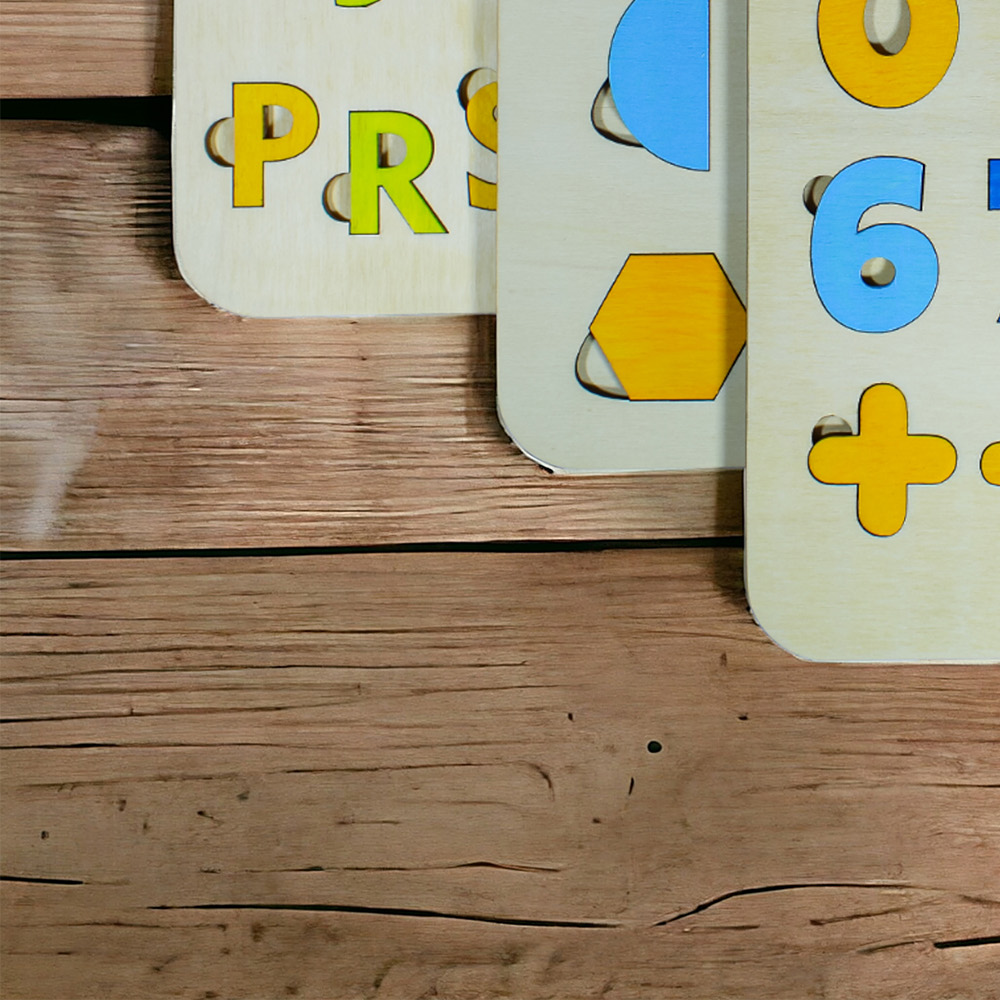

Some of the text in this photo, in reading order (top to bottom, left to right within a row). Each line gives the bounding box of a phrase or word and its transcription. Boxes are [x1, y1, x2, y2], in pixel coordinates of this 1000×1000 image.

[232, 81, 320, 208] P
[348, 110, 449, 235] R
[809, 155, 940, 334] 6
